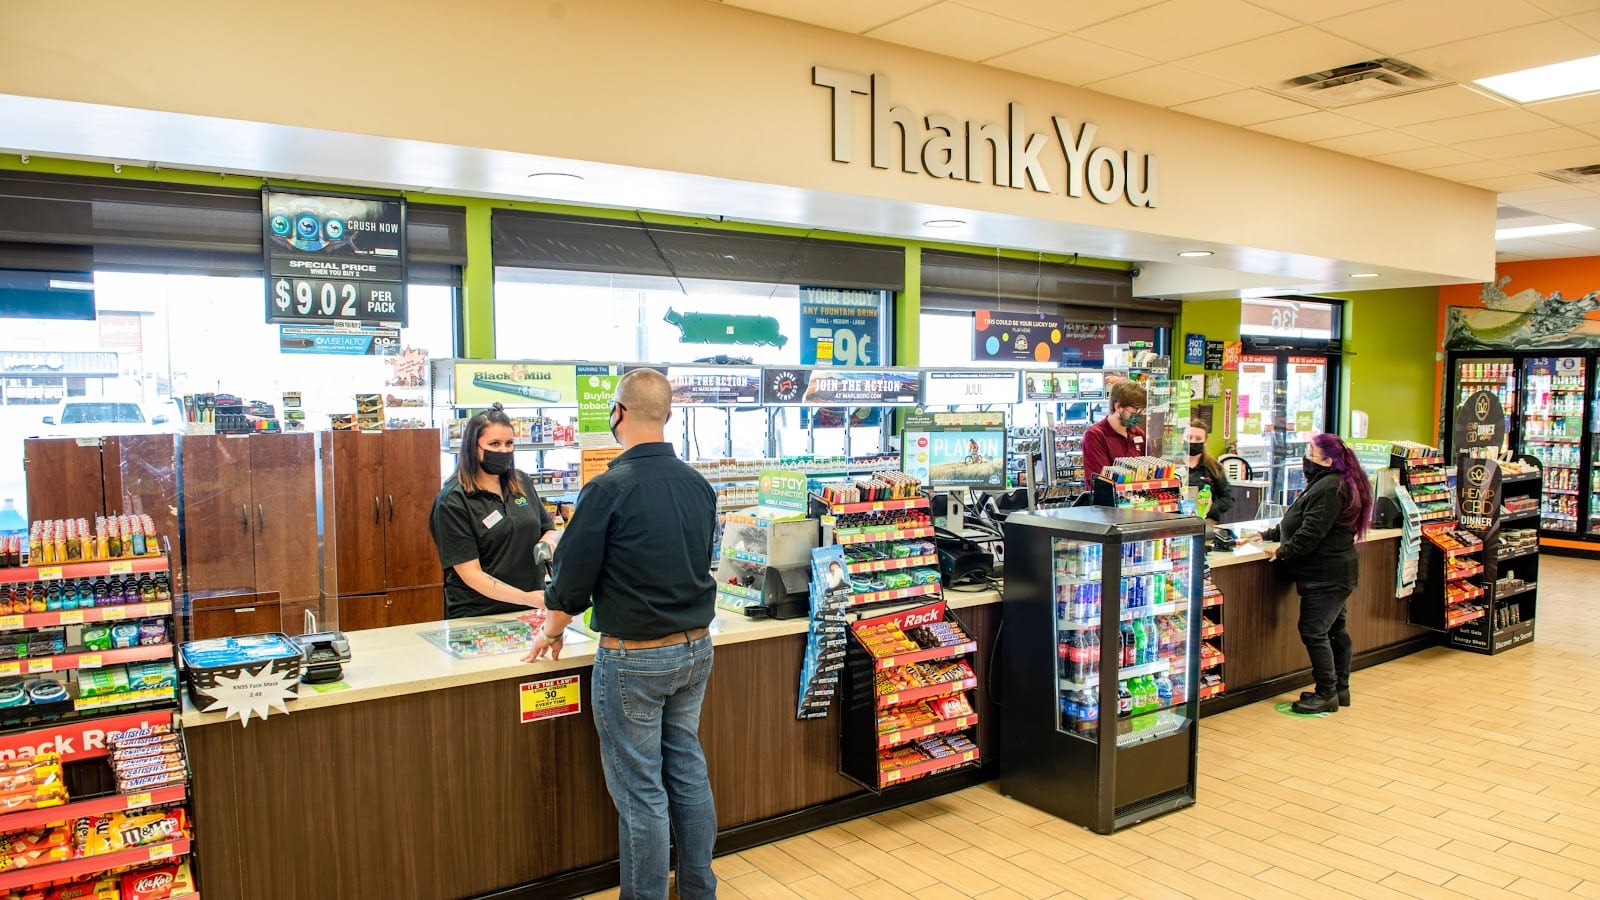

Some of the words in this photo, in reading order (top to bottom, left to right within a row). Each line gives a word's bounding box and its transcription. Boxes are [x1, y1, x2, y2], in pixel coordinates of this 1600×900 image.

[811, 66, 1051, 194] Thank
[1051, 115, 1159, 209] You
[348, 220, 376, 232] CRUSH
[379, 223, 399, 234] NOW
[289, 260, 339, 270] SPECIAL
[341, 263, 377, 272] PRICE
[310, 268, 328, 276] WHEN
[275, 278, 357, 317] $9.02
[371, 290, 392, 302] PER
[807, 288, 840, 304] YOUR
[843, 291, 873, 306] BODY
[367, 301, 396, 313] PACK
[803, 306, 818, 315] ANY
[821, 307, 855, 316] FOUNTAIN
[857, 308, 878, 317] DRINK
[1189, 339, 1203, 347] HOT
[1188, 347, 1202, 357] 100
[474, 372, 510, 380] Black
[524, 371, 551, 380] Mild
[674, 375, 694, 386] JOIN
[696, 375, 714, 386] THE
[716, 375, 748, 386] ACTION
[815, 379, 838, 392] JOIN
[843, 379, 861, 392] THE
[865, 379, 900, 392] ACTION
[964, 383, 983, 395] JUUL
[584, 391, 616, 402] Buying
[580, 402, 614, 410] tobac
[934, 437, 971, 457] PLAY
[979, 437, 999, 457] ON
[1355, 443, 1389, 452] STAY
[772, 477, 804, 490] STAY
[772, 490, 803, 498] CONNECTED
[1461, 487, 1495, 499] HEMP
[1461, 500, 1494, 514] CBD
[1461, 515, 1492, 527] DINNER
[903, 608, 939, 628] Rack
[1454, 636, 1471, 644] Energy
[1495, 638, 1513, 650] Discover
[1520, 631, 1533, 640] Secret
[114, 728, 151, 741] SATISFIES
[0, 735, 75, 760] nack
[127, 764, 165, 778] SATISFIES
[128, 774, 168, 787] SNICKERS
